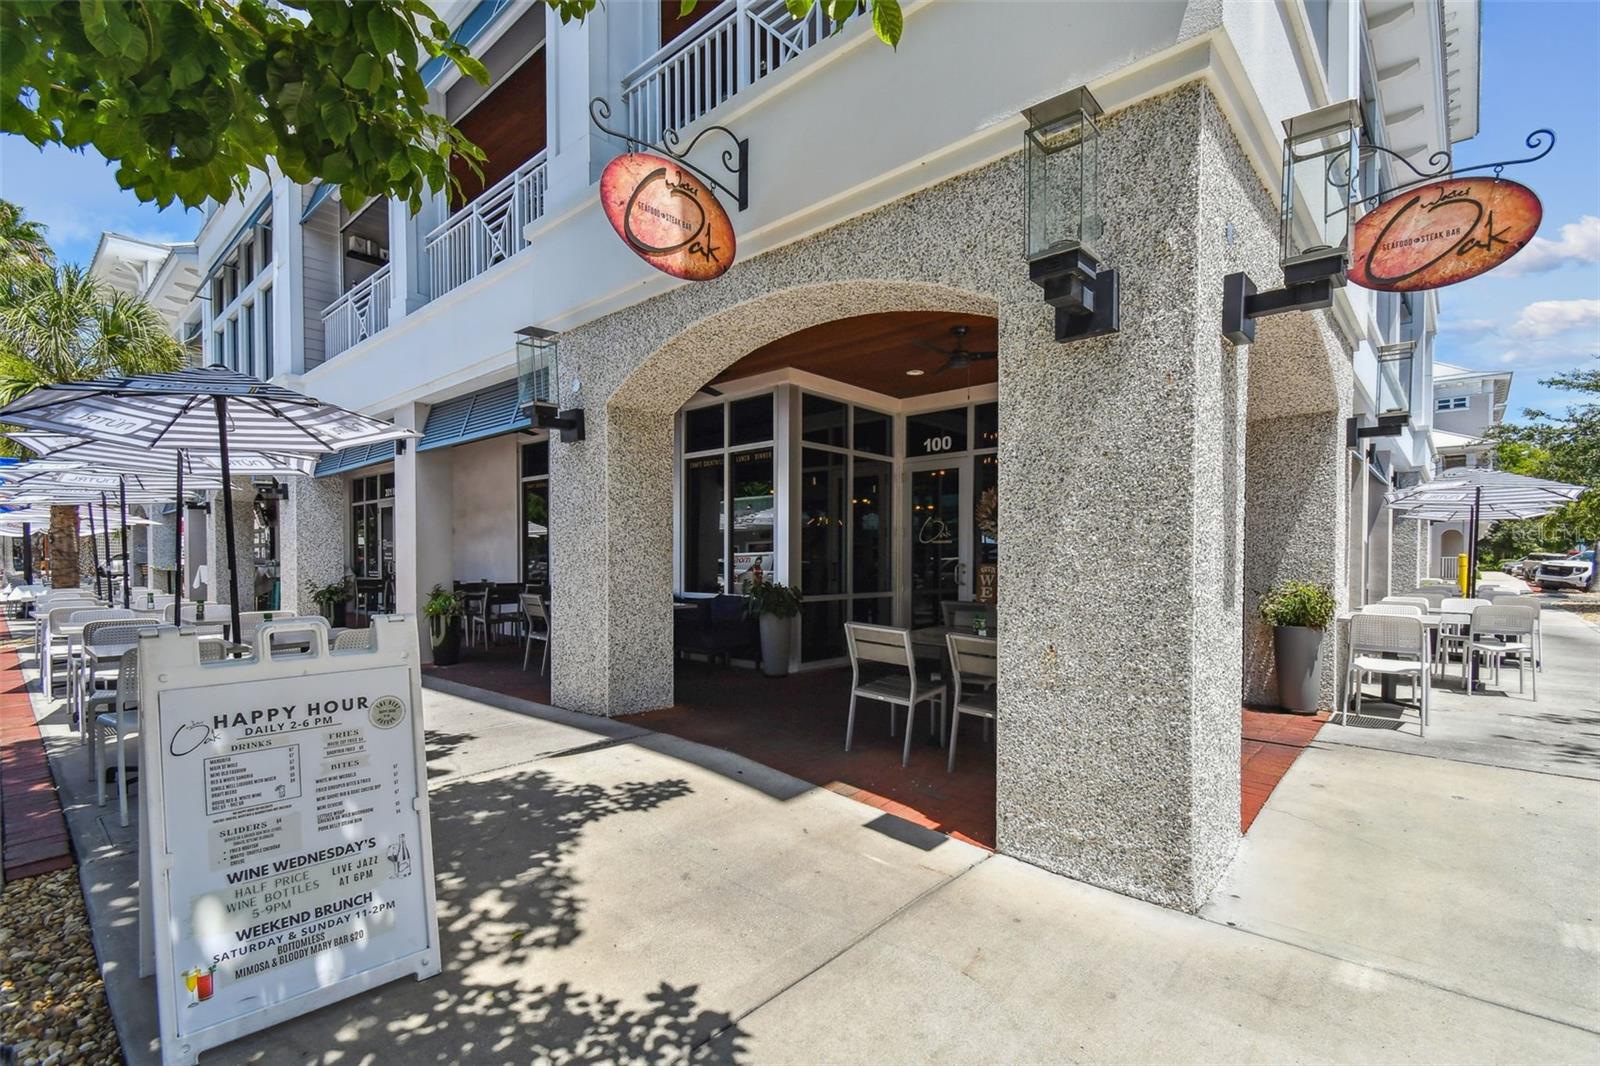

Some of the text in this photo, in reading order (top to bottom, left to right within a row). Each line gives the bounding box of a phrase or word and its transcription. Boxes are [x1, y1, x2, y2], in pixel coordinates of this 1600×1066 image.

[638, 201, 660, 218] SEAFOOD
[682, 220, 692, 230] BAR
[1382, 227, 1461, 251] SEAFOOD STEAK BAR
[923, 435, 952, 452] 100
[214, 706, 296, 729] HAPPY
[308, 697, 368, 716] HOUR
[245, 716, 333, 736] DAILY 2-6 PM
[329, 729, 359, 739] FRIES
[231, 740, 273, 751] DRINKS
[331, 760, 359, 770] BITES
[219, 821, 267, 838] SLIDERS
[227, 865, 269, 884] WINE
[273, 837, 377, 872] WEDNESDAY'S
[332, 856, 378, 876] LIVE JAZZ
[235, 871, 310, 898] HALF PRICE
[339, 869, 373, 887] AT 6PM
[226, 880, 320, 913] WINE BOTTLES
[235, 891, 373, 942] WEEKEND BRUNCH
[252, 900, 292, 918] 5-9PM
[213, 900, 396, 964] SATURDAY & SUNDAY 11-2PM
[277, 932, 326, 955] BOTTOMLESS
[235, 929, 364, 979] MIMOSA & BLOODY MARY BAR $20
